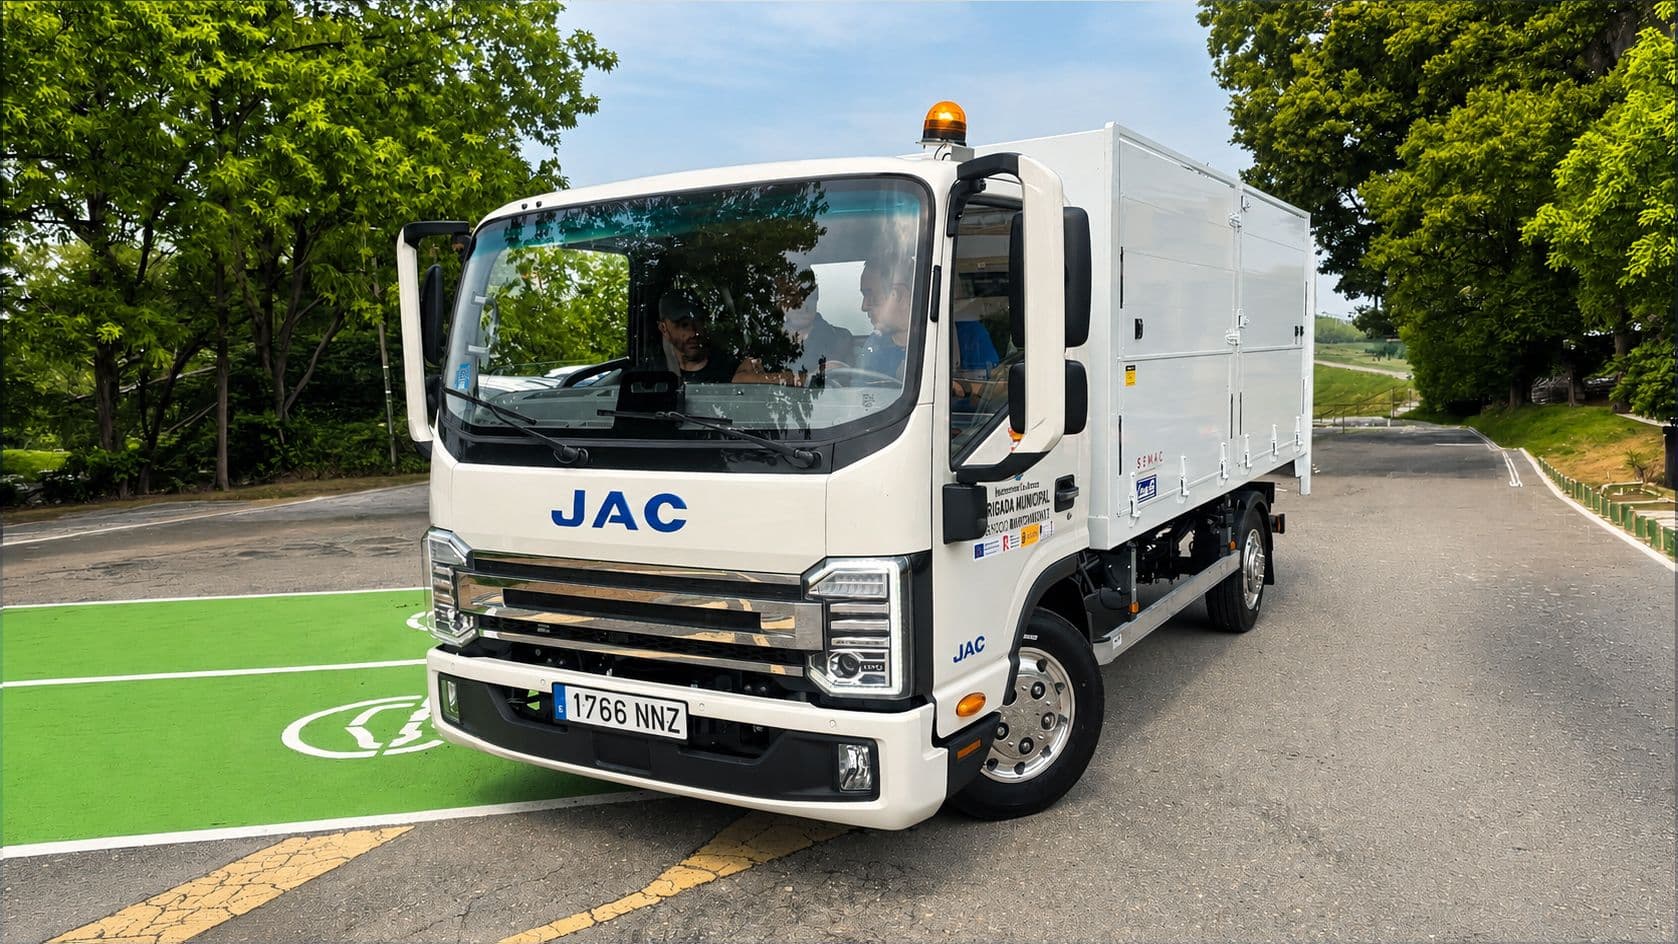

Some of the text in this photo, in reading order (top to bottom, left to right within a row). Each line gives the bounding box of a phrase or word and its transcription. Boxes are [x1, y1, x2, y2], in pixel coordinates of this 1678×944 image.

[1136, 450, 1163, 469] SEMAC
[551, 489, 688, 533] JAC
[986, 498, 1015, 517] RIGADA
[952, 635, 985, 663] JAC
[573, 692, 627, 725] 1766
[635, 702, 681, 734] NNZ
